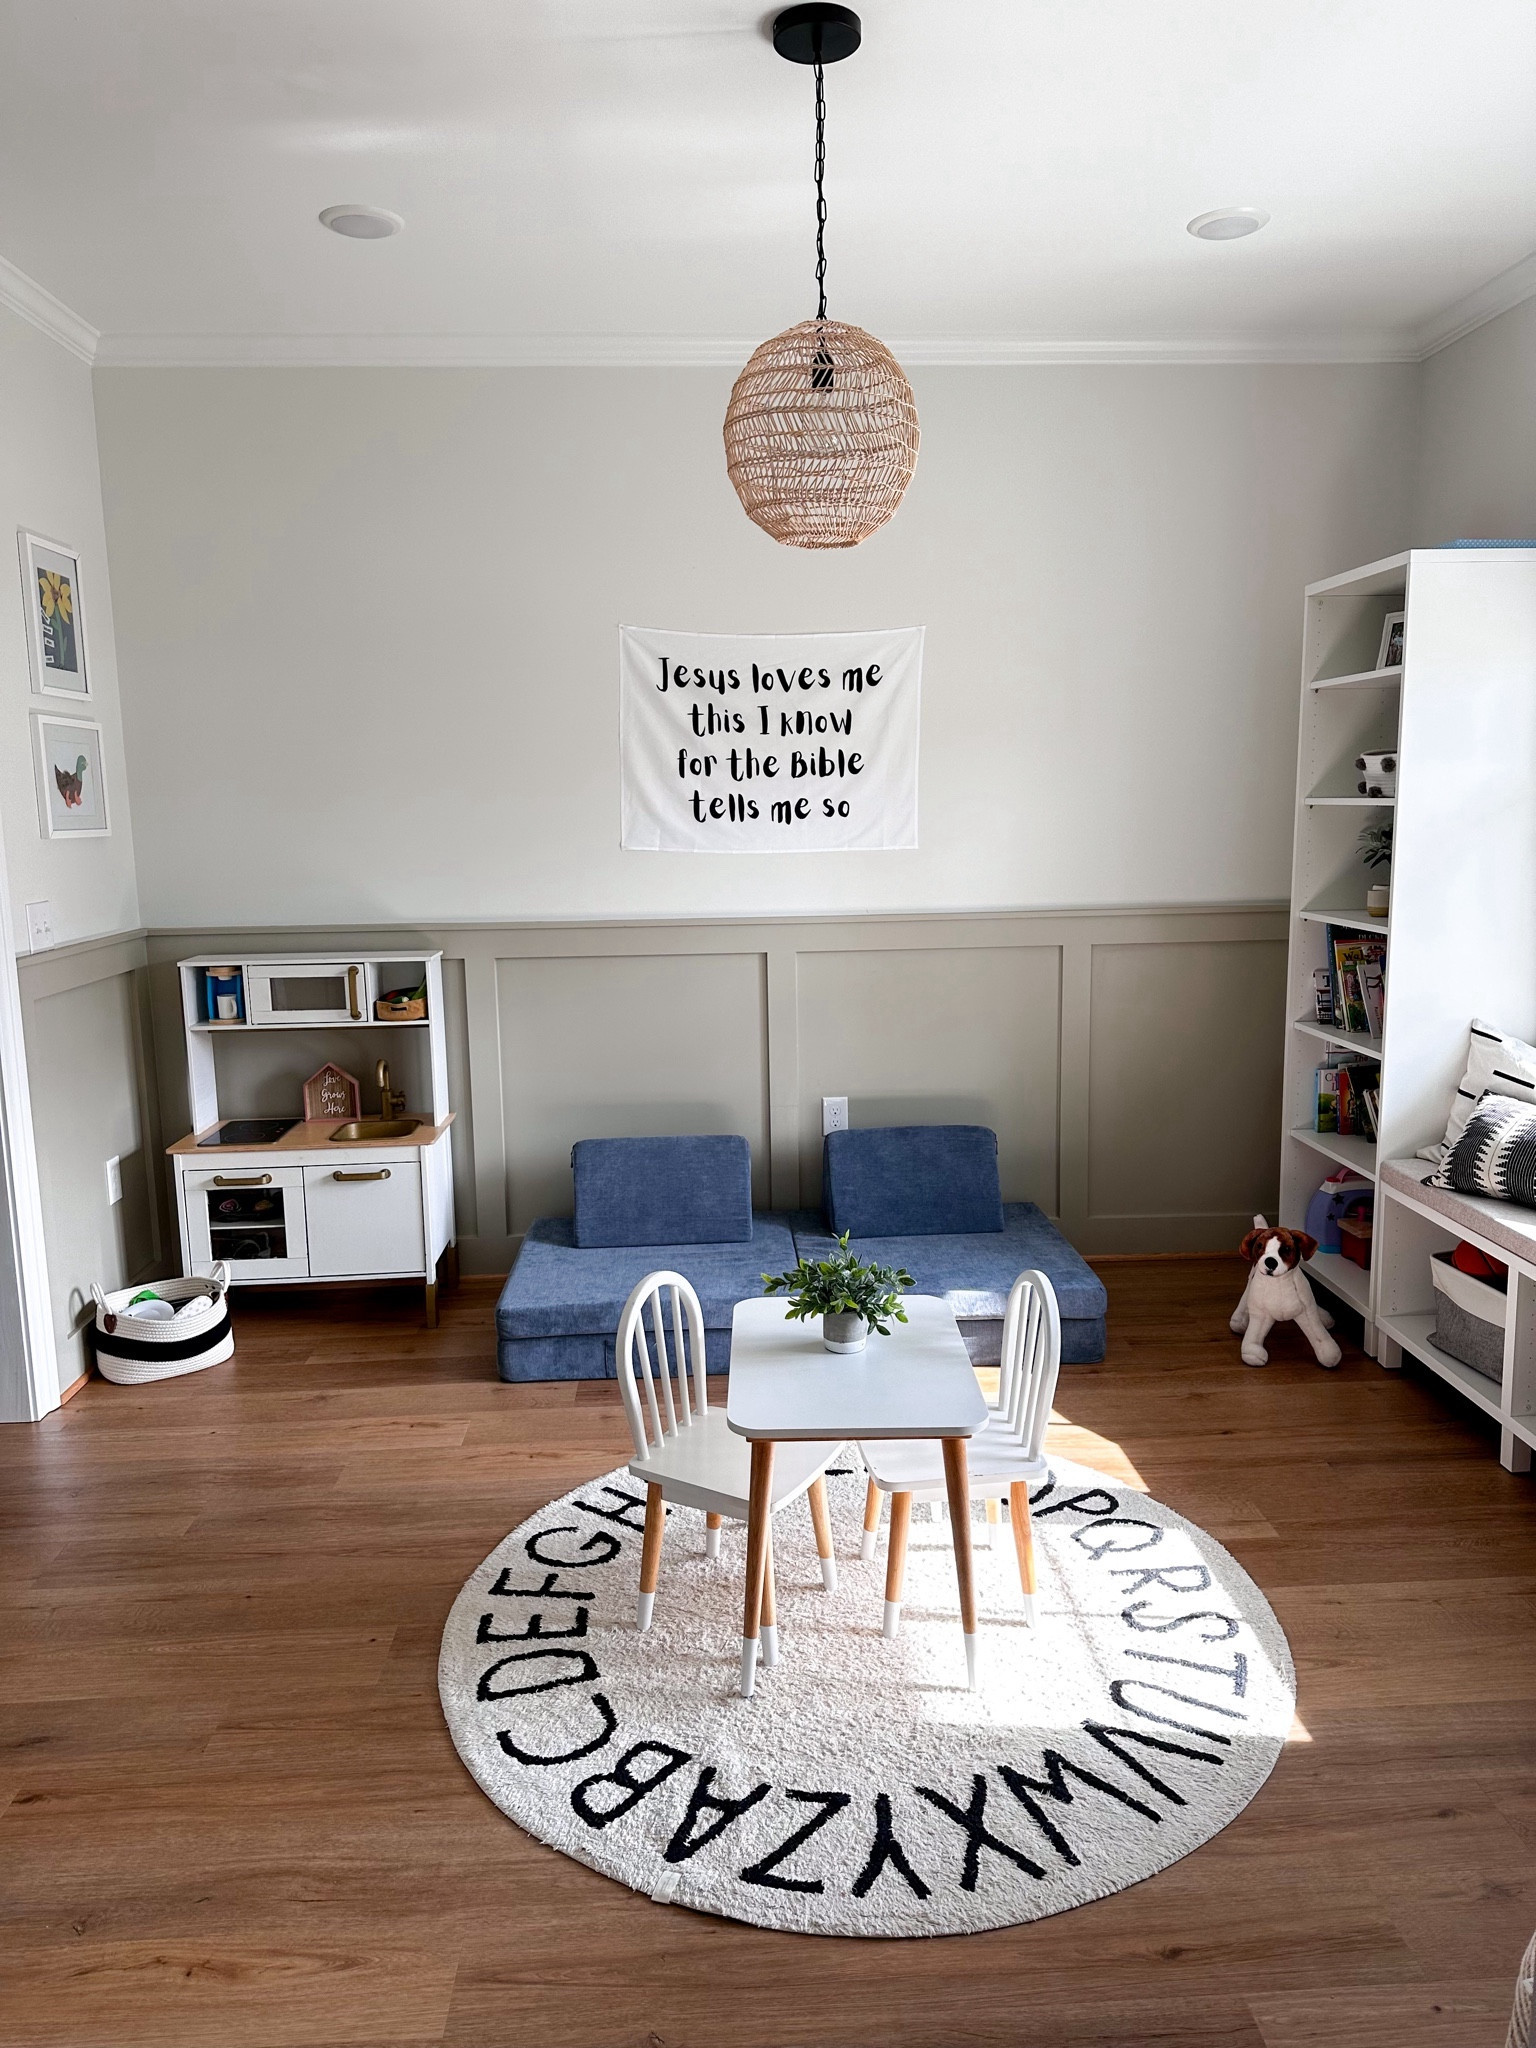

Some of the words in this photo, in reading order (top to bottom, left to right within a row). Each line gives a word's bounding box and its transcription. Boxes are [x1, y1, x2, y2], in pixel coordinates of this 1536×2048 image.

[656, 657, 741, 695] Jesus
[752, 663, 831, 693] loves
[842, 664, 884, 693] me
[687, 702, 746, 737] this
[757, 705, 770, 736] I
[780, 708, 852, 737] know
[677, 748, 718, 779] for
[725, 747, 780, 782] the
[790, 746, 865, 778] Bible
[688, 789, 760, 823] tells
[770, 797, 812, 825] me
[822, 798, 851, 818] so
[321, 1089, 346, 1103] Grows
[323, 1071, 342, 1086] Love
[323, 1101, 346, 1115] Here
